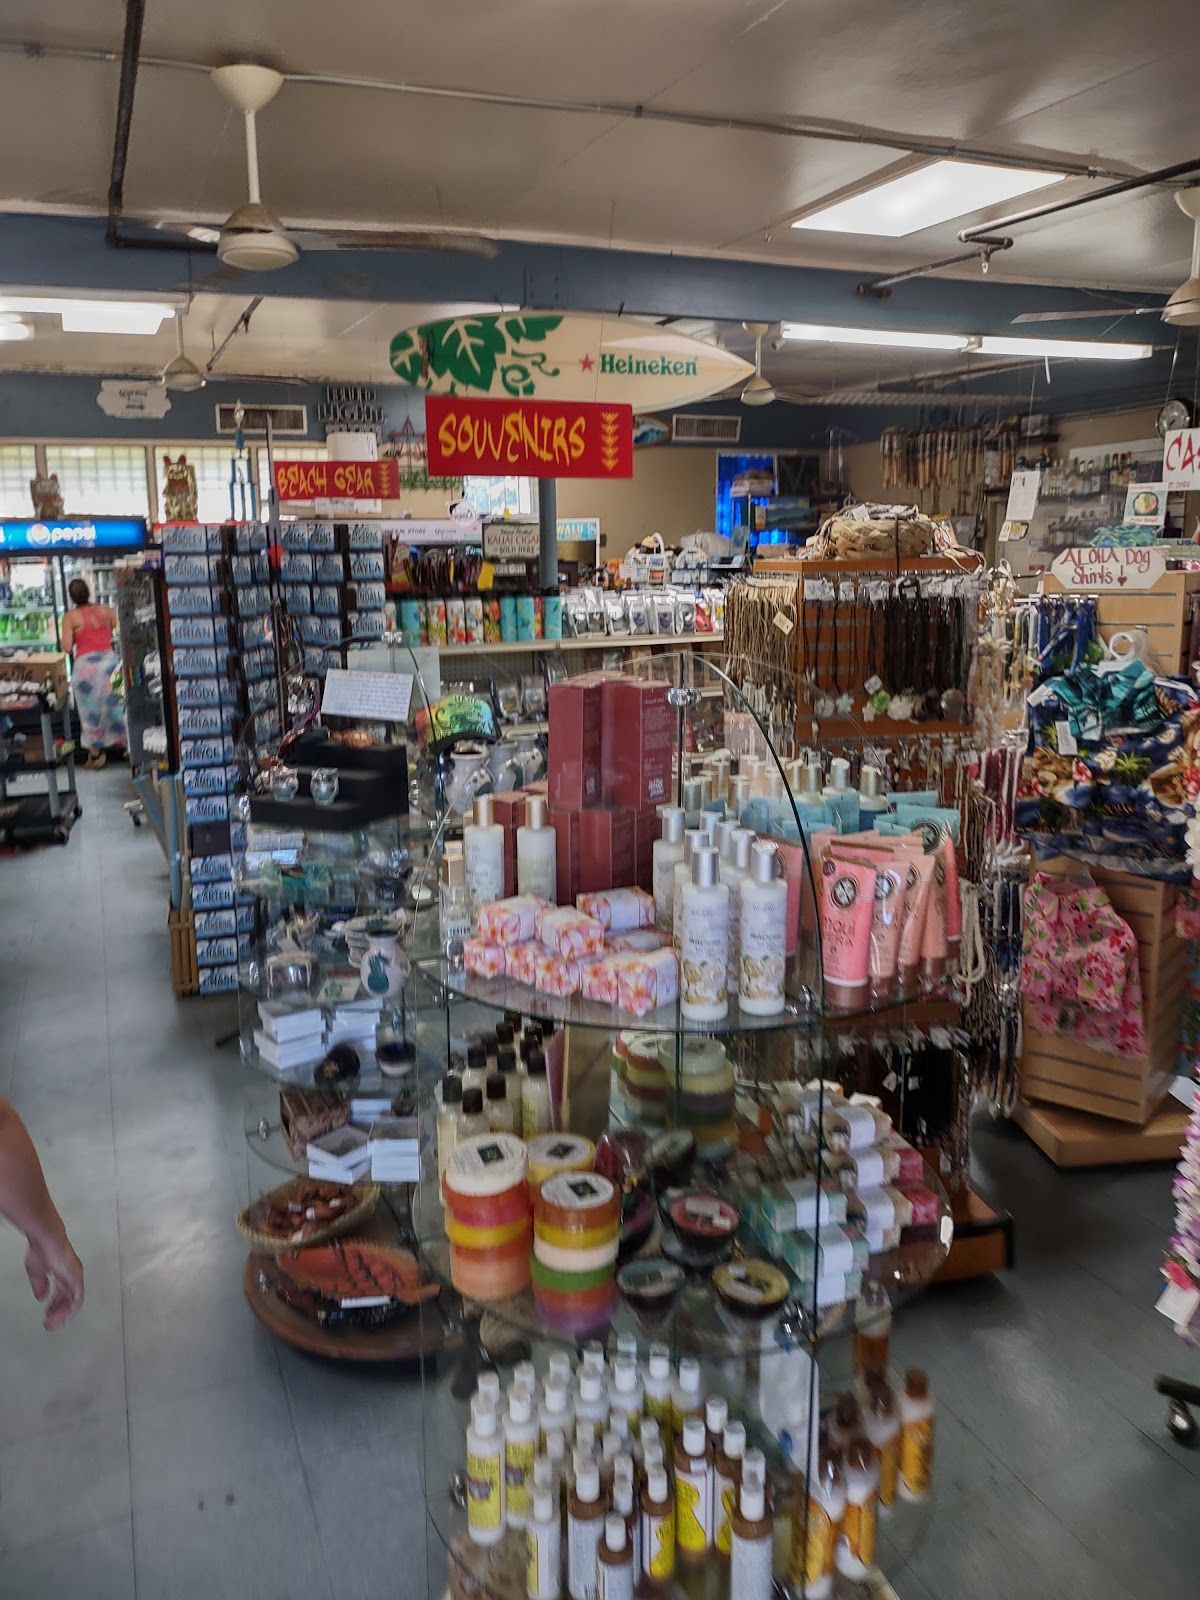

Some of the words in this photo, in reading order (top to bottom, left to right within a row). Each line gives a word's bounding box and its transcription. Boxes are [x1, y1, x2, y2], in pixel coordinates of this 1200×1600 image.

[600, 353, 698, 377] Heineken
[438, 409, 586, 466] SOUVENIRS
[1166, 431, 1200, 475] CA
[277, 463, 328, 498] BEACH
[334, 463, 375, 496] GEAR
[51, 526, 96, 544] pepsi
